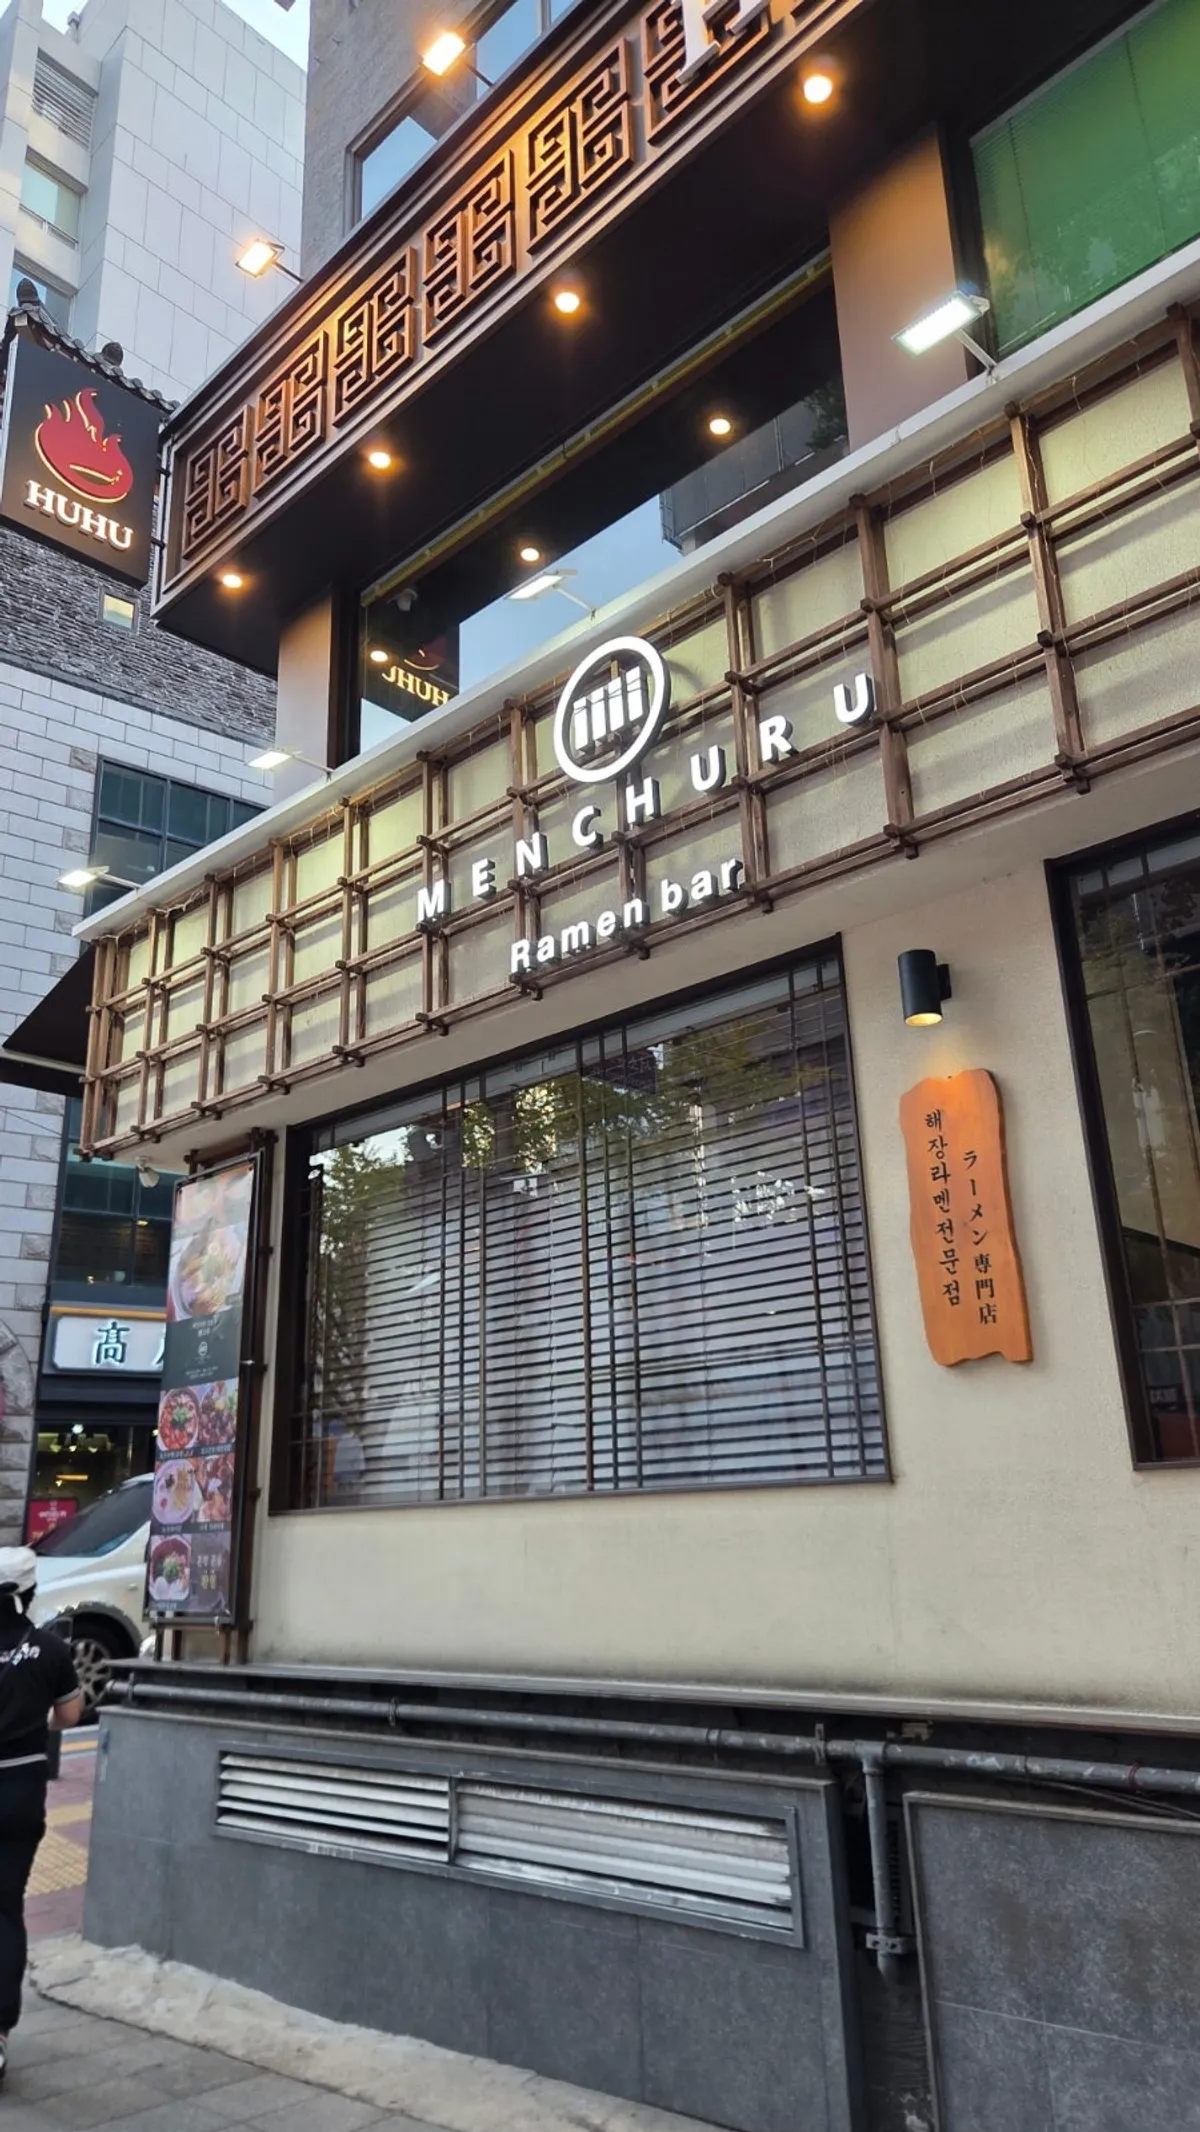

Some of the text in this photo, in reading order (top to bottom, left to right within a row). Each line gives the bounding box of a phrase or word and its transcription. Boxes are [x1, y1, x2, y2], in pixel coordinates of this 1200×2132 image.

[24, 480, 134, 550] HUHU
[416, 673, 877, 922] MENCHURU
[510, 857, 743, 974] Ramen bar
[925, 1109, 960, 1306] 해장라멘전문점
[963, 1150, 997, 1325] ラーメン専門店
